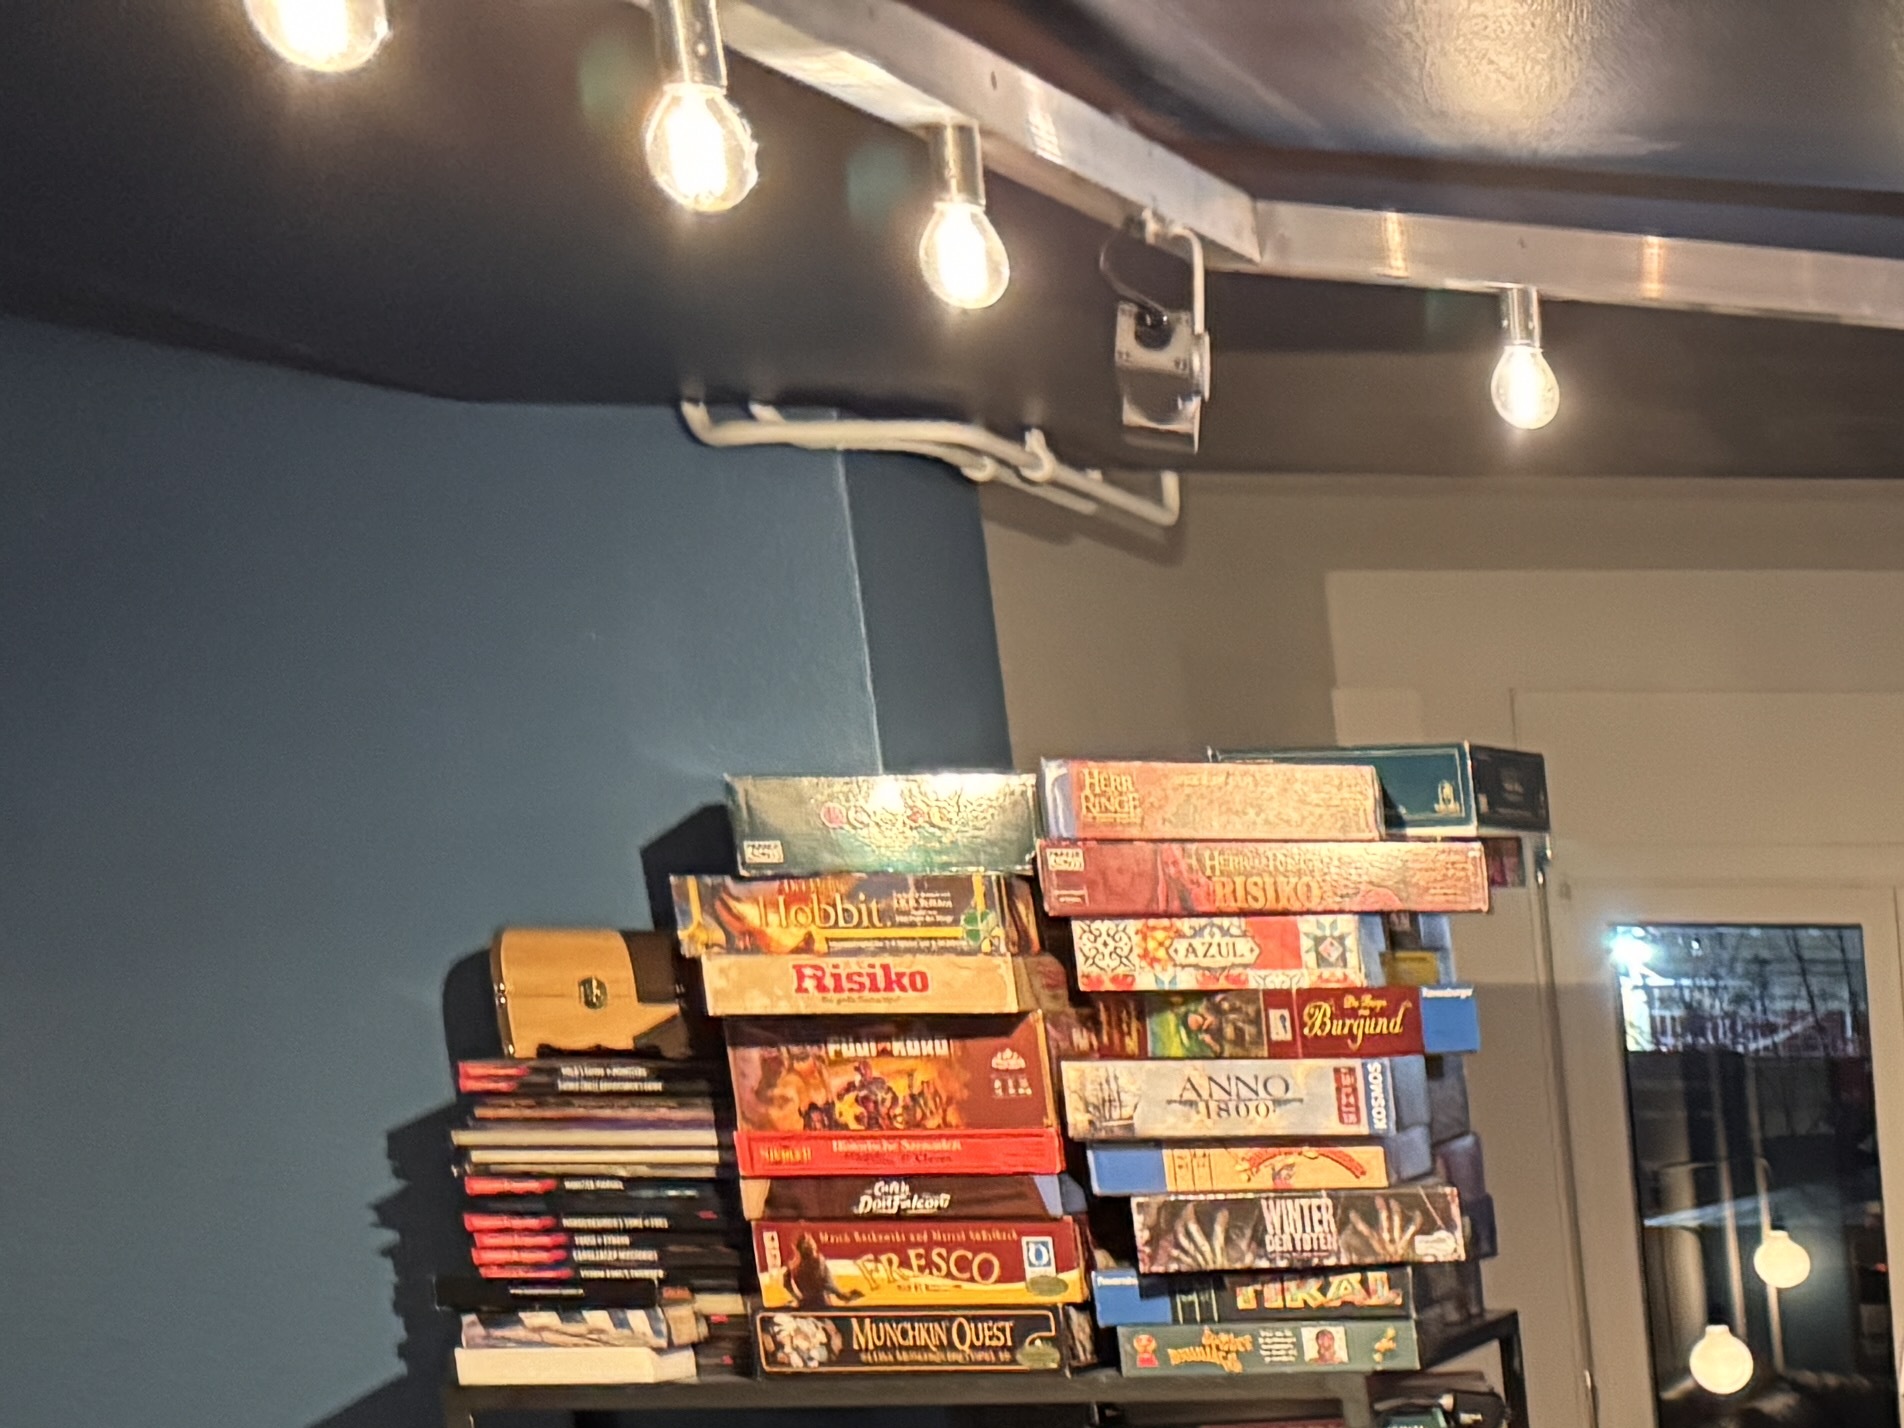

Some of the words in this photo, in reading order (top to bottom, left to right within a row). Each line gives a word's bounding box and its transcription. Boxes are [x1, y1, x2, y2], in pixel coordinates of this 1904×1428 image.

[1212, 873, 1323, 909] RISIKO
[1183, 937, 1245, 960] AZUL
[792, 962, 929, 994] Risiko
[1301, 1000, 1413, 1051] Burgund
[1178, 1073, 1291, 1099] ANNO
[1366, 1061, 1388, 1130] KOSMOS
[1200, 1101, 1271, 1121] 1800
[1260, 1197, 1336, 1235] WINTER
[855, 1247, 1001, 1292] FRESCO
[1236, 1271, 1403, 1311] TIKAL
[850, 1317, 949, 1351] MUNCHKIN
[951, 1317, 1014, 1352] QUEST
